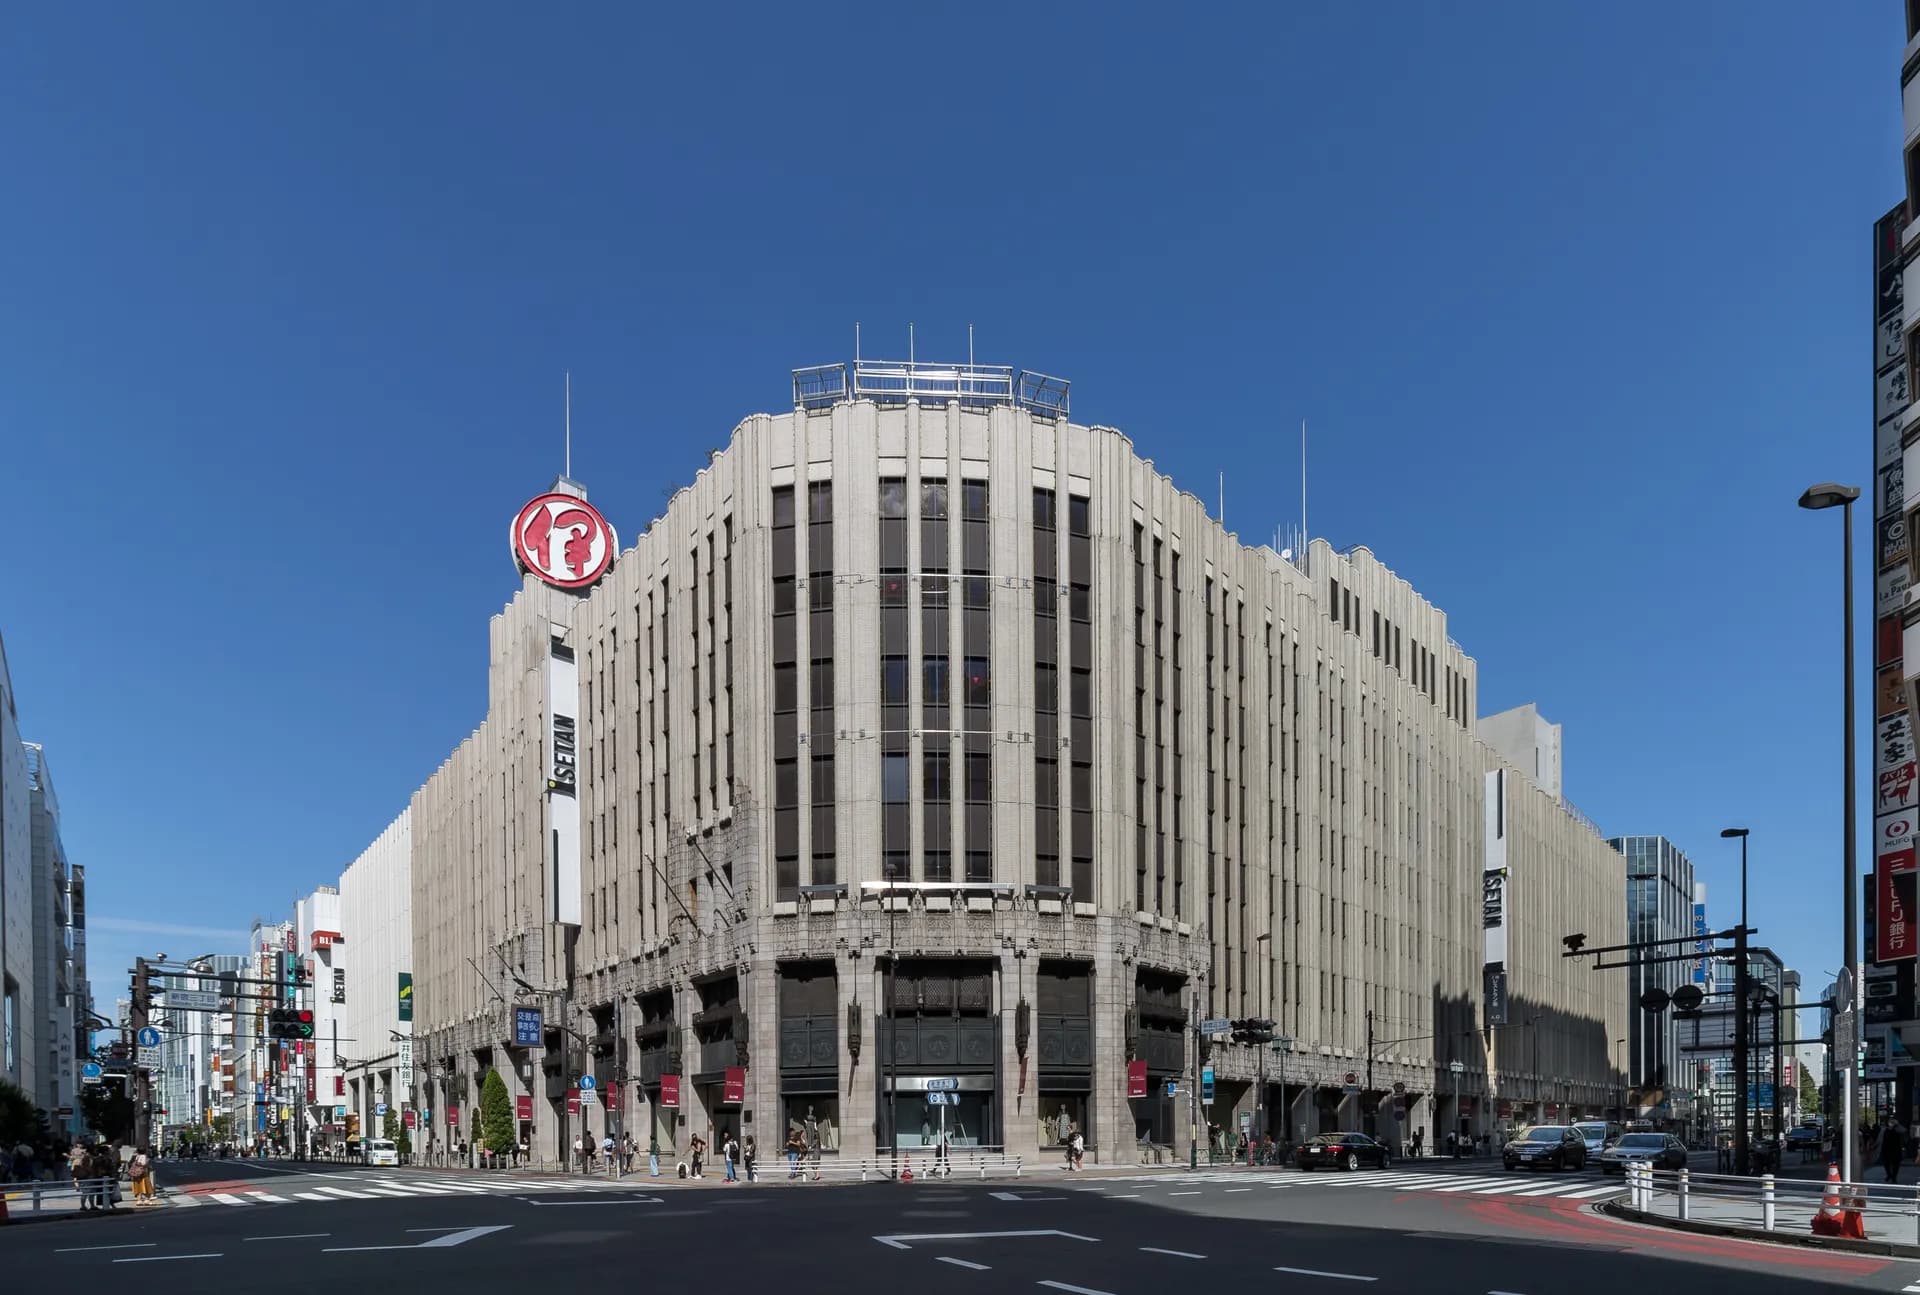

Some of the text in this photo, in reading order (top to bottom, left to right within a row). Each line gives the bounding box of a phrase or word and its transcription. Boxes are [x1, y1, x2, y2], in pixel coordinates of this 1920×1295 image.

[553, 713, 576, 800] ISETAN
[1885, 838, 1909, 849] MUFG
[1484, 869, 1504, 929] ISETAN
[1890, 857, 1905, 950] 三UFJ銀行
[334, 968, 345, 1004] ISETAN
